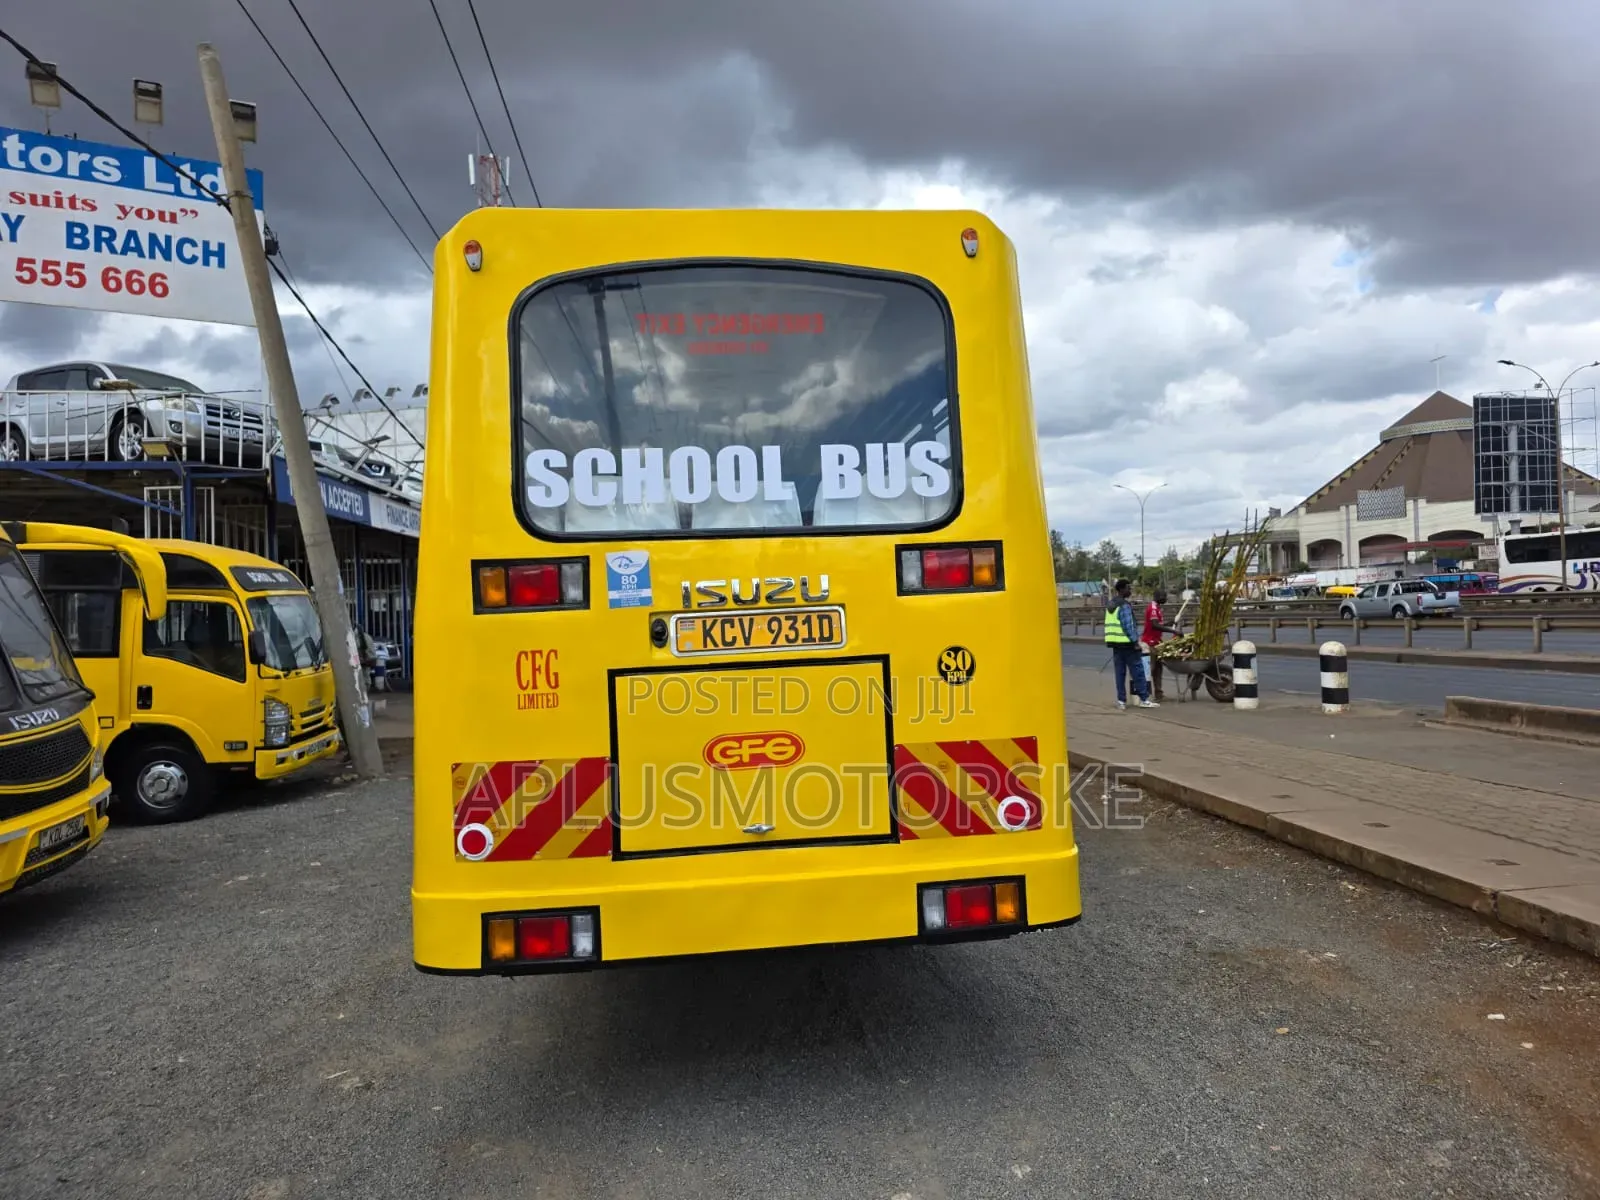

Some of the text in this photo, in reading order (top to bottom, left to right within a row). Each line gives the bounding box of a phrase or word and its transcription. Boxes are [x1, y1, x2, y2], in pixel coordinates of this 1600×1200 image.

[2, 133, 229, 198] tors Ltd
[9, 190, 98, 212] suits
[65, 221, 226, 269] BRANCH
[15, 257, 169, 298] 555 666
[525, 440, 951, 508] SCHOOL BUS
[328, 486, 364, 517] ACCEPTED
[621, 575, 638, 585] 80
[681, 574, 830, 609] ISUZU
[701, 614, 835, 649] KCV 931D
[516, 648, 560, 691] CFG
[941, 649, 971, 672] 80
[516, 692, 559, 710] LIMITED
[9, 708, 60, 730] ISUZU
